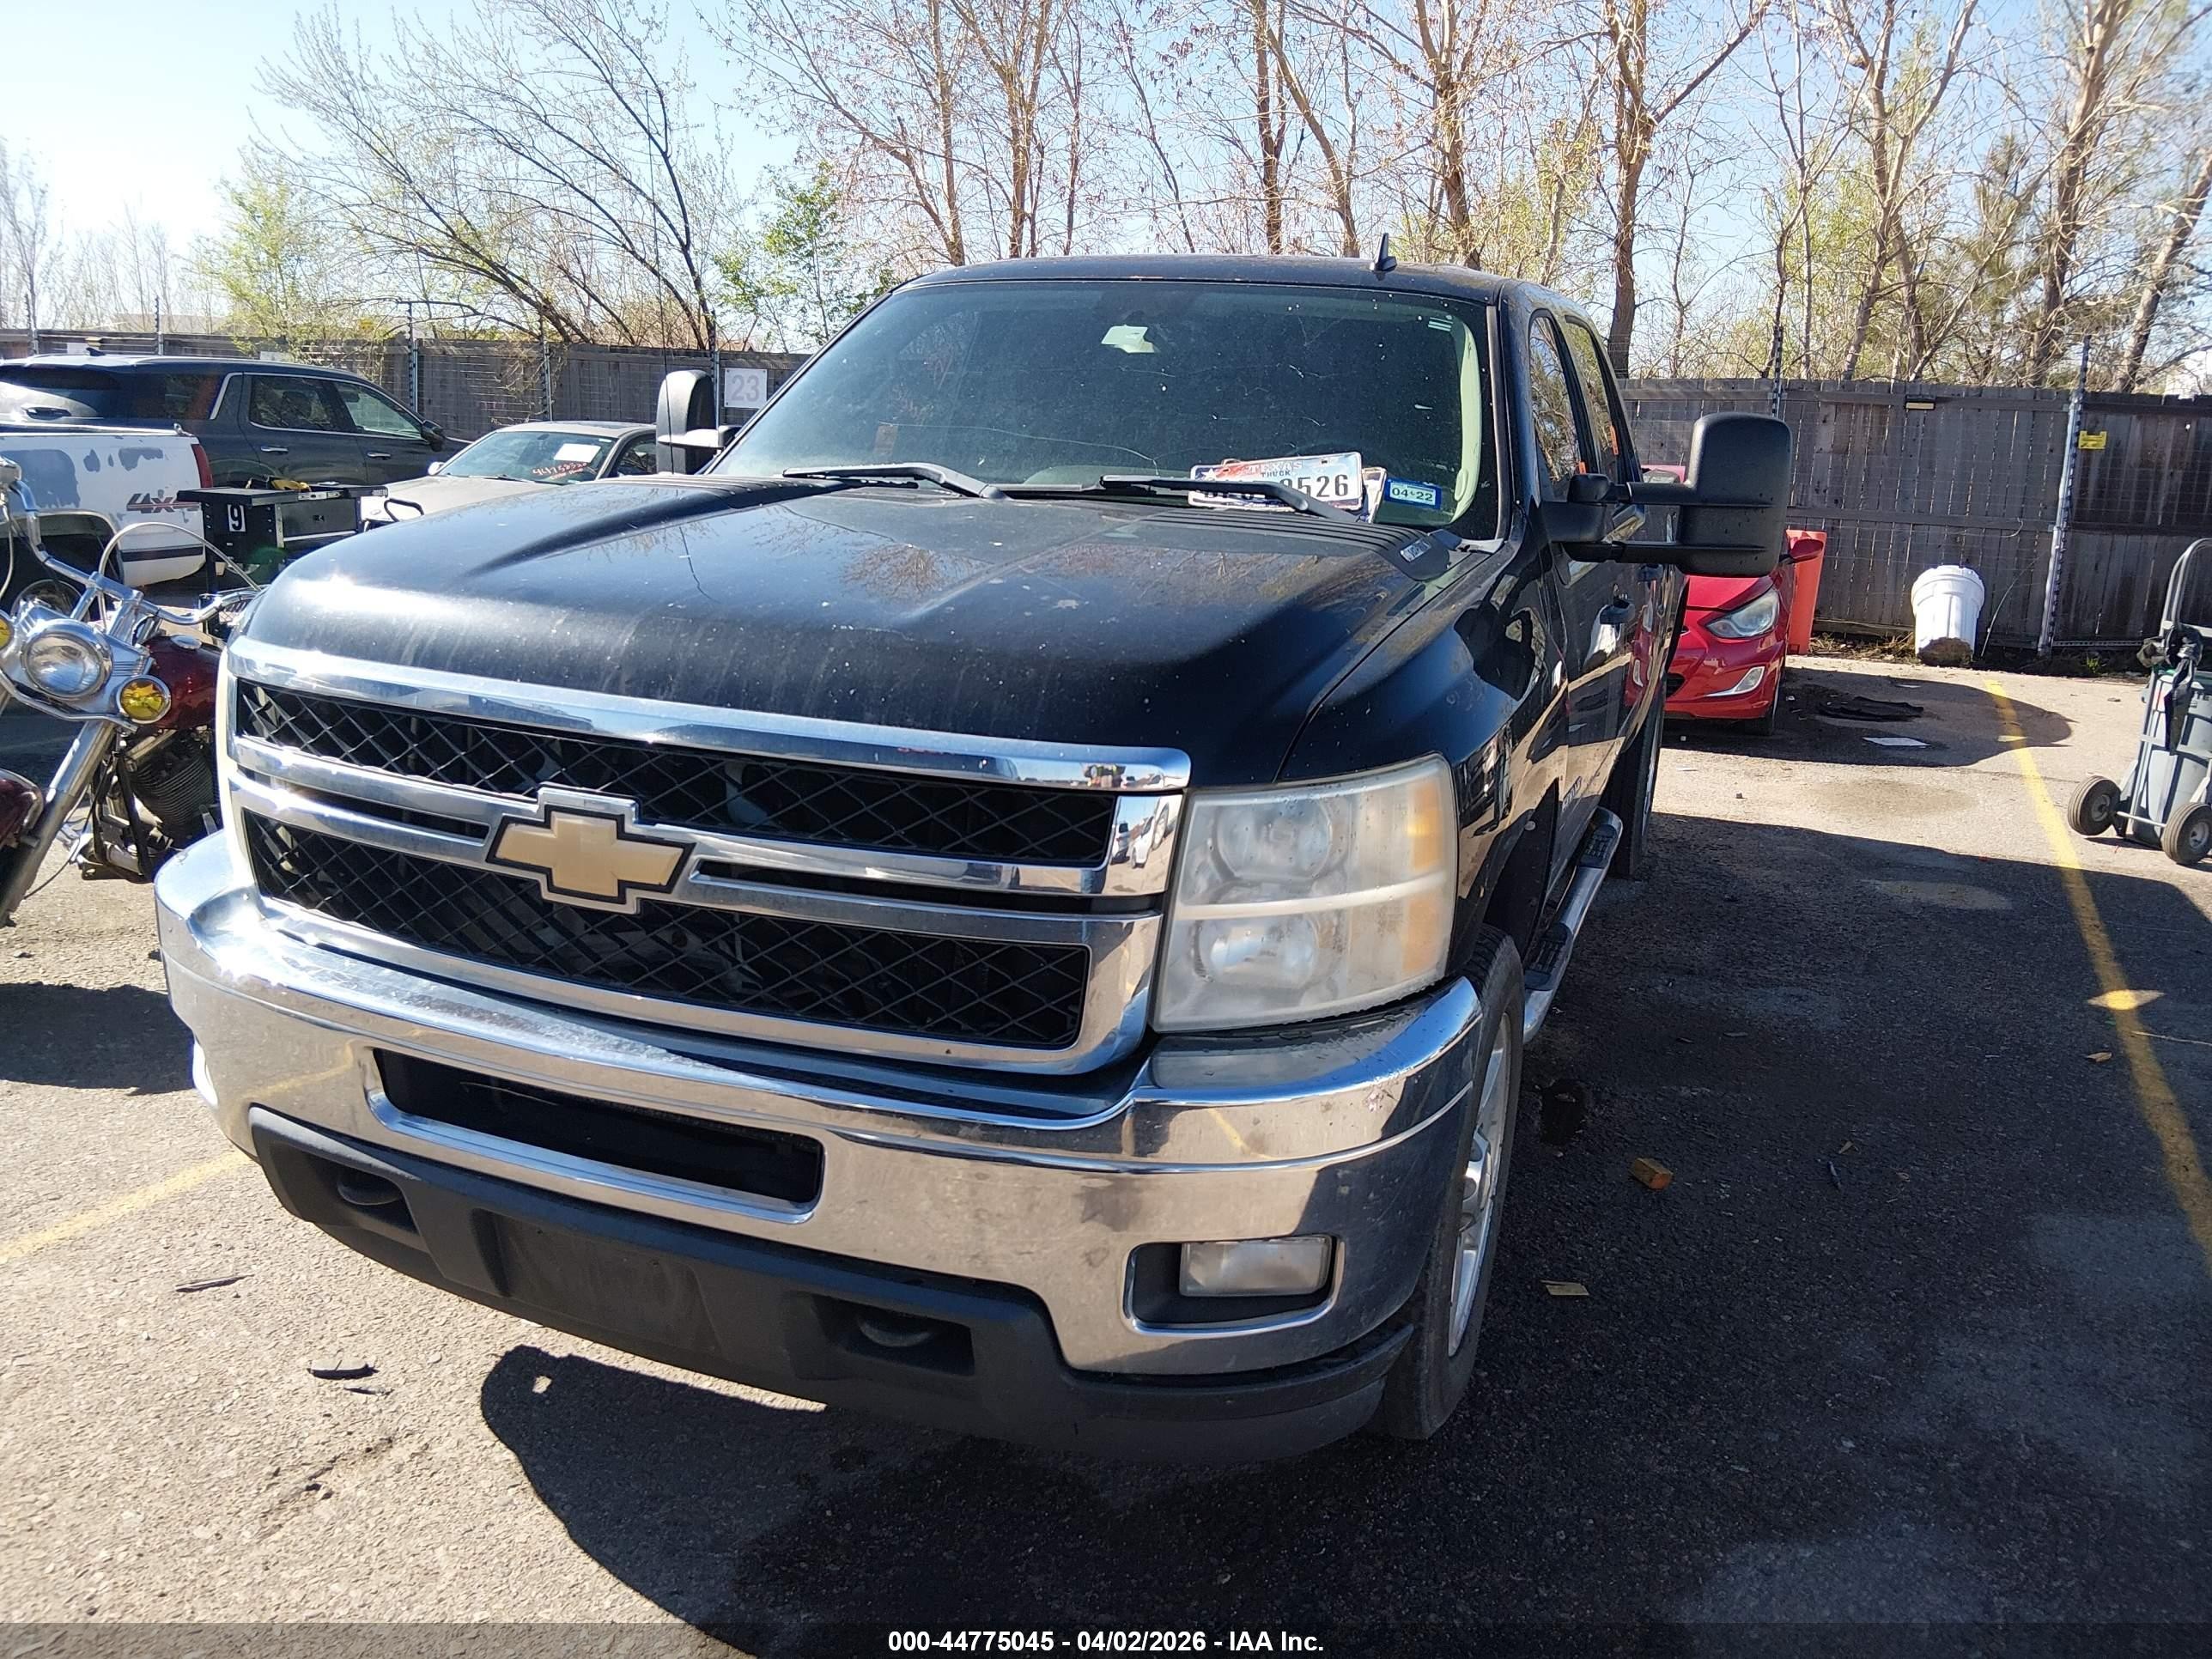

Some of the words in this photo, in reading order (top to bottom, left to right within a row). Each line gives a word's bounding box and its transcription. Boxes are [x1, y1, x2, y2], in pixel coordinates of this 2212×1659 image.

[732, 374, 760, 402] 23
[1247, 461, 1303, 474] TEXAS
[1261, 469, 1291, 477] TRUCK
[229, 505, 243, 531] 9
